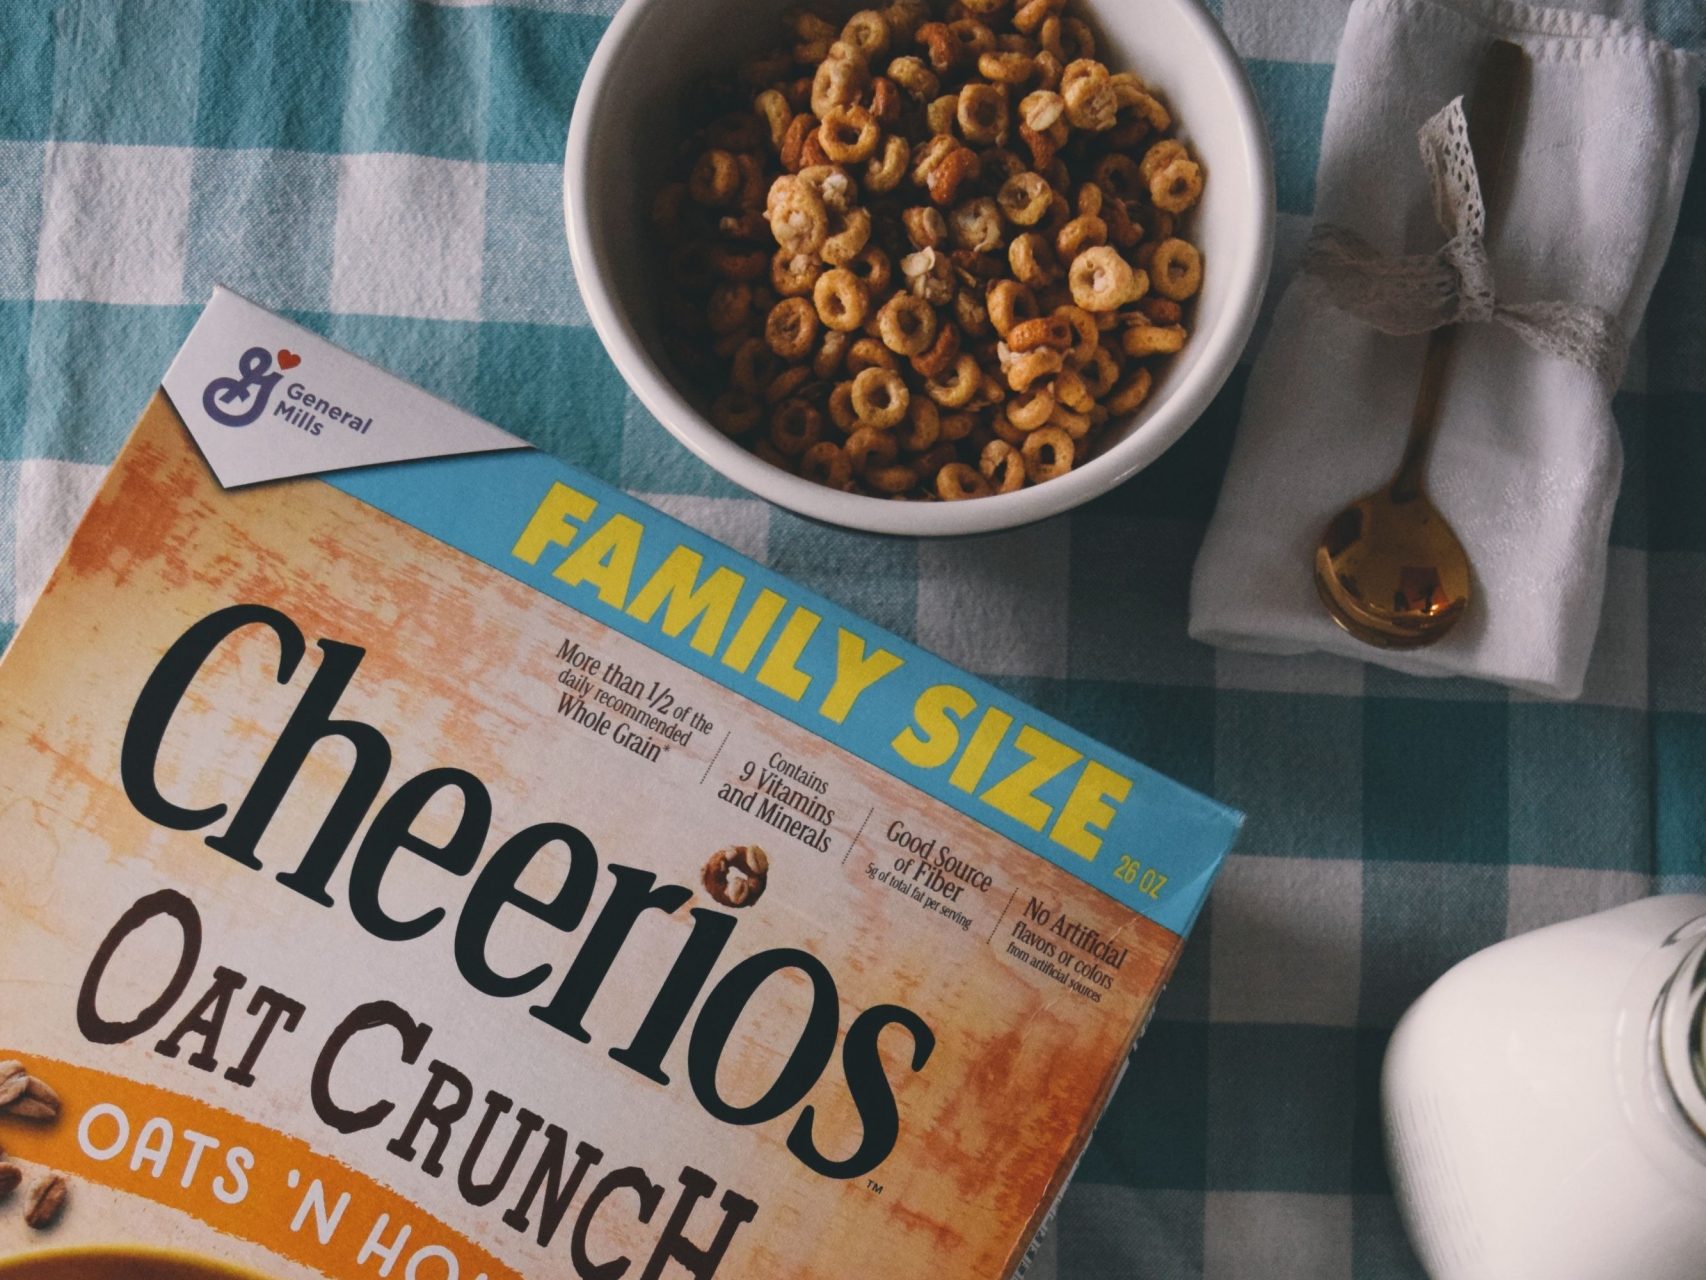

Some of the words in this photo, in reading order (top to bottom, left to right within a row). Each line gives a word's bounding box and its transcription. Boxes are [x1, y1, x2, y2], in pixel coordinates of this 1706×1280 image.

[273, 400, 324, 436] Mills
[286, 382, 373, 435] General
[511, 482, 904, 724] FAMILY
[891, 685, 1133, 862] SIZE
[555, 638, 601, 676] More
[602, 662, 645, 699] than
[646, 681, 675, 715] 1/2
[672, 706, 693, 722] of
[689, 711, 714, 735] the
[556, 692, 612, 736] Whole
[558, 668, 595, 698] daily
[593, 688, 693, 747] recommended
[739, 761, 756, 782] 9
[757, 768, 835, 826] Vitamins
[768, 752, 829, 795] Contains
[717, 783, 758, 813] and
[755, 797, 832, 853] Minerals
[120, 603, 935, 1179] Cheerios
[886, 820, 936, 860] Good
[934, 846, 993, 893] Source
[894, 858, 915, 874] of
[912, 860, 964, 902] Fiber
[1113, 855, 1140, 885] 26
[1138, 868, 1168, 899] OZ
[865, 862, 879, 880] 5g
[878, 870, 891, 883] of
[889, 876, 912, 895] total
[910, 886, 926, 903] fat
[922, 897, 940, 911] per
[939, 905, 973, 931] serving
[1011, 920, 1057, 958] flavors
[1057, 949, 1074, 967] or
[1074, 960, 1114, 990] colors
[1022, 896, 1050, 927] No
[1050, 914, 1129, 970] Artificial
[76, 888, 306, 1087] OAT
[1006, 941, 1030, 962] from
[1029, 953, 1069, 985] artificial
[1070, 978, 1102, 1003] sources
[77, 1103, 255, 1204] OATS
[287, 1169, 350, 1246] 'N
